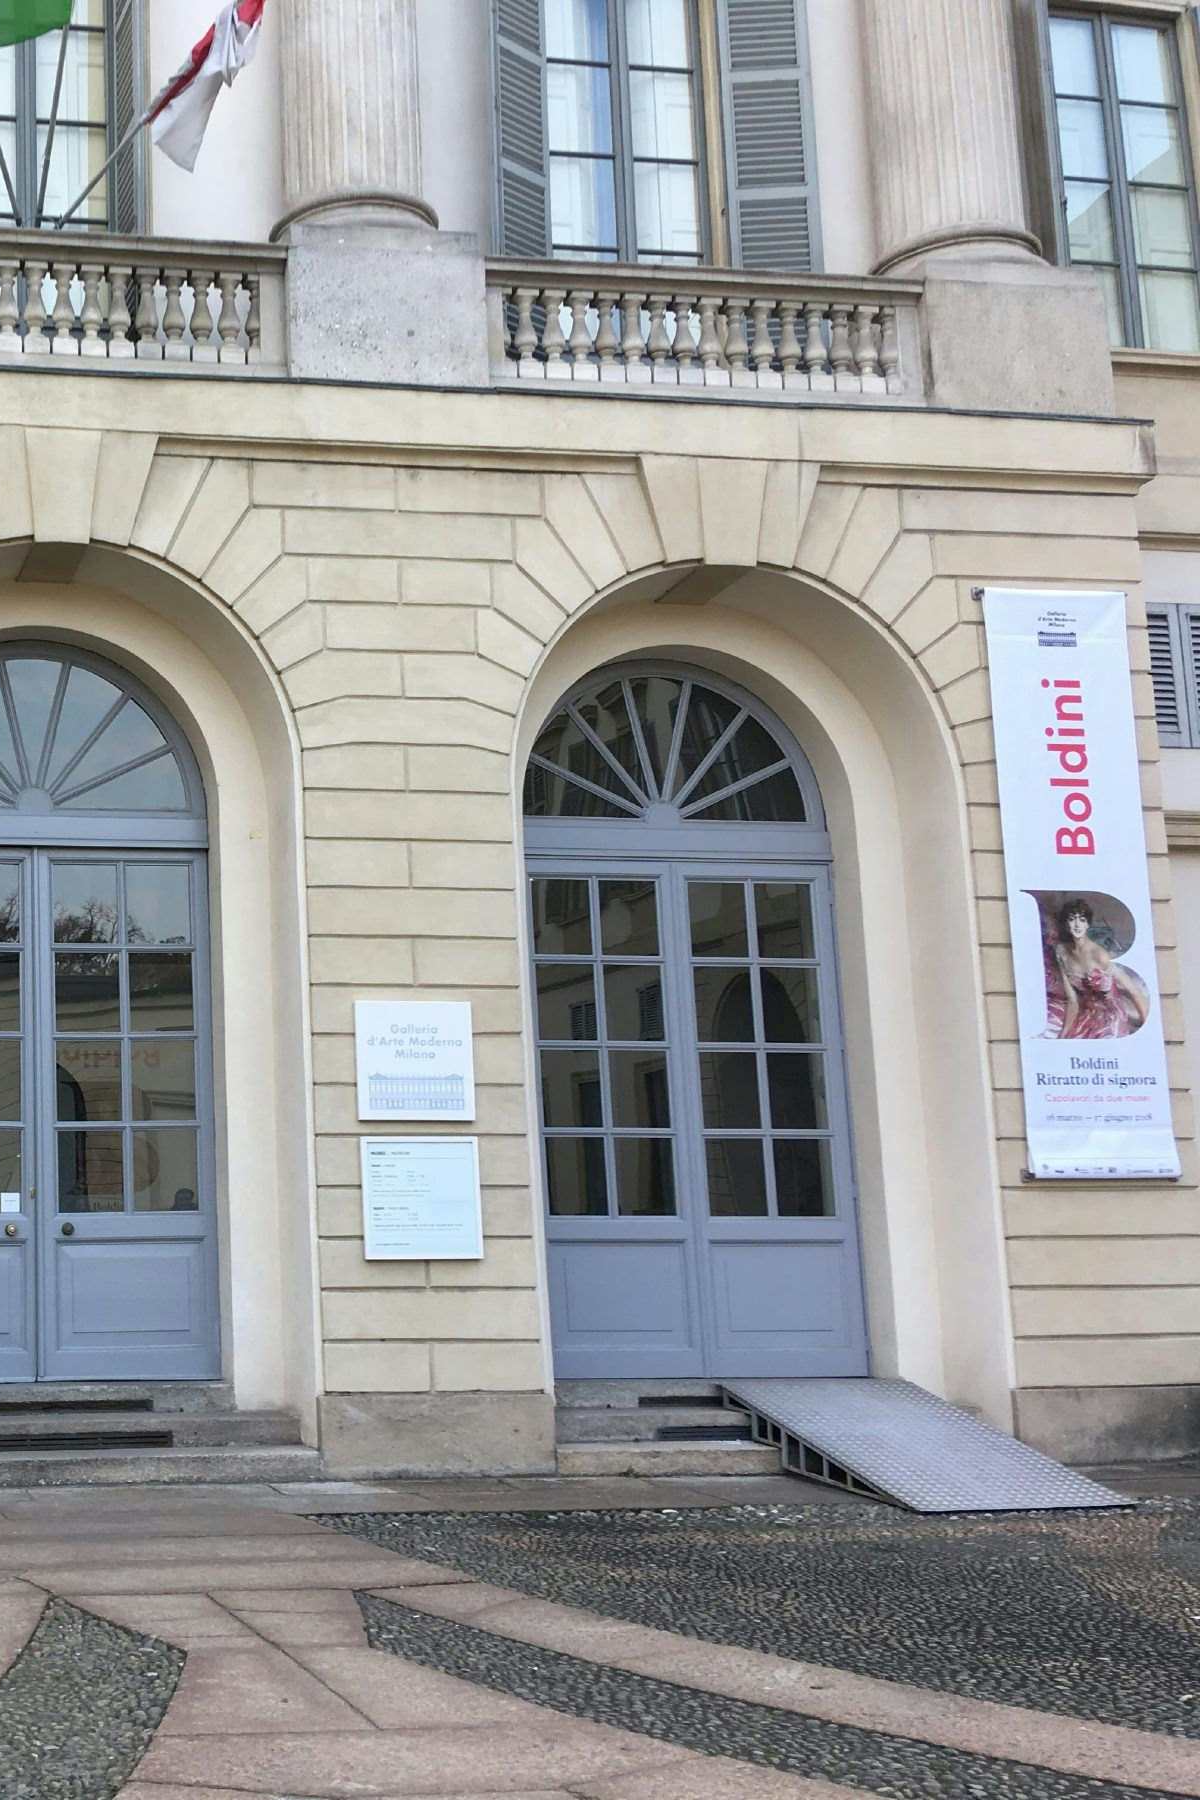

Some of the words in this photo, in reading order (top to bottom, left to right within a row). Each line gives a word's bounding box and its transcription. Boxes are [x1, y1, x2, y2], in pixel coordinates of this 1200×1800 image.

[1041, 678, 1096, 856] Boldini
[390, 1024, 438, 1034] Galleria
[367, 1035, 405, 1046] d'Arte
[409, 1036, 463, 1047] Moderna
[395, 1049, 436, 1059] Milano
[1070, 1056, 1119, 1070] Boldini
[1036, 1072, 1089, 1086] Ritratto
[1092, 1073, 1105, 1086] di
[1108, 1074, 1157, 1089] signora
